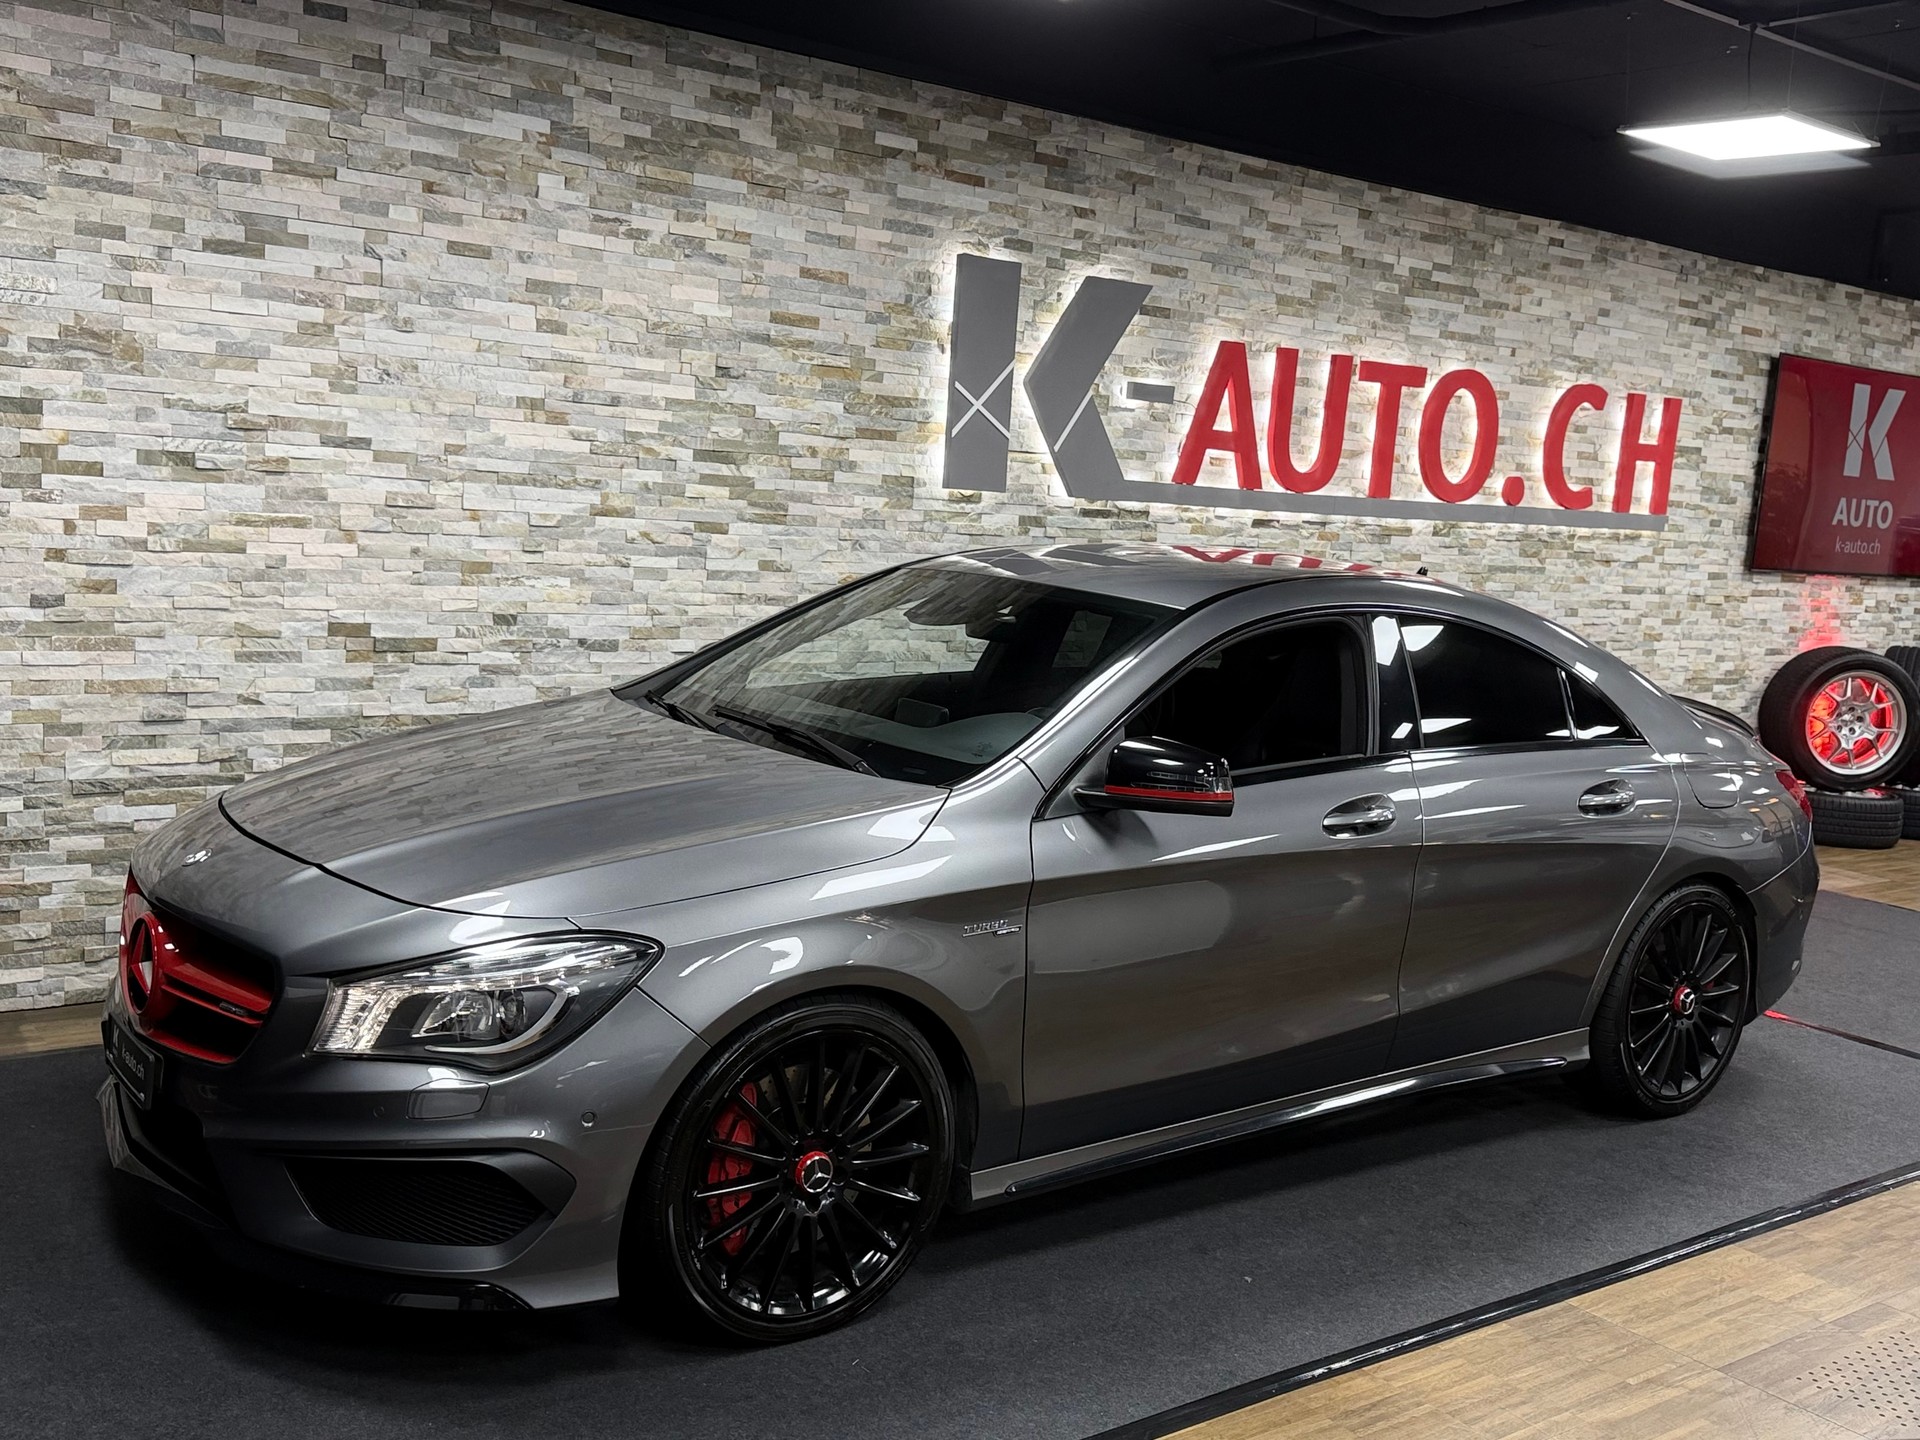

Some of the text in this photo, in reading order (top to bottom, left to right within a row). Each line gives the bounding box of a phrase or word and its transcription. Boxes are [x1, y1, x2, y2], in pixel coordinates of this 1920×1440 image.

[1843, 382, 1907, 481] K
[1832, 497, 1894, 529] AUTO
[1835, 536, 1881, 555] k-auto.ch
